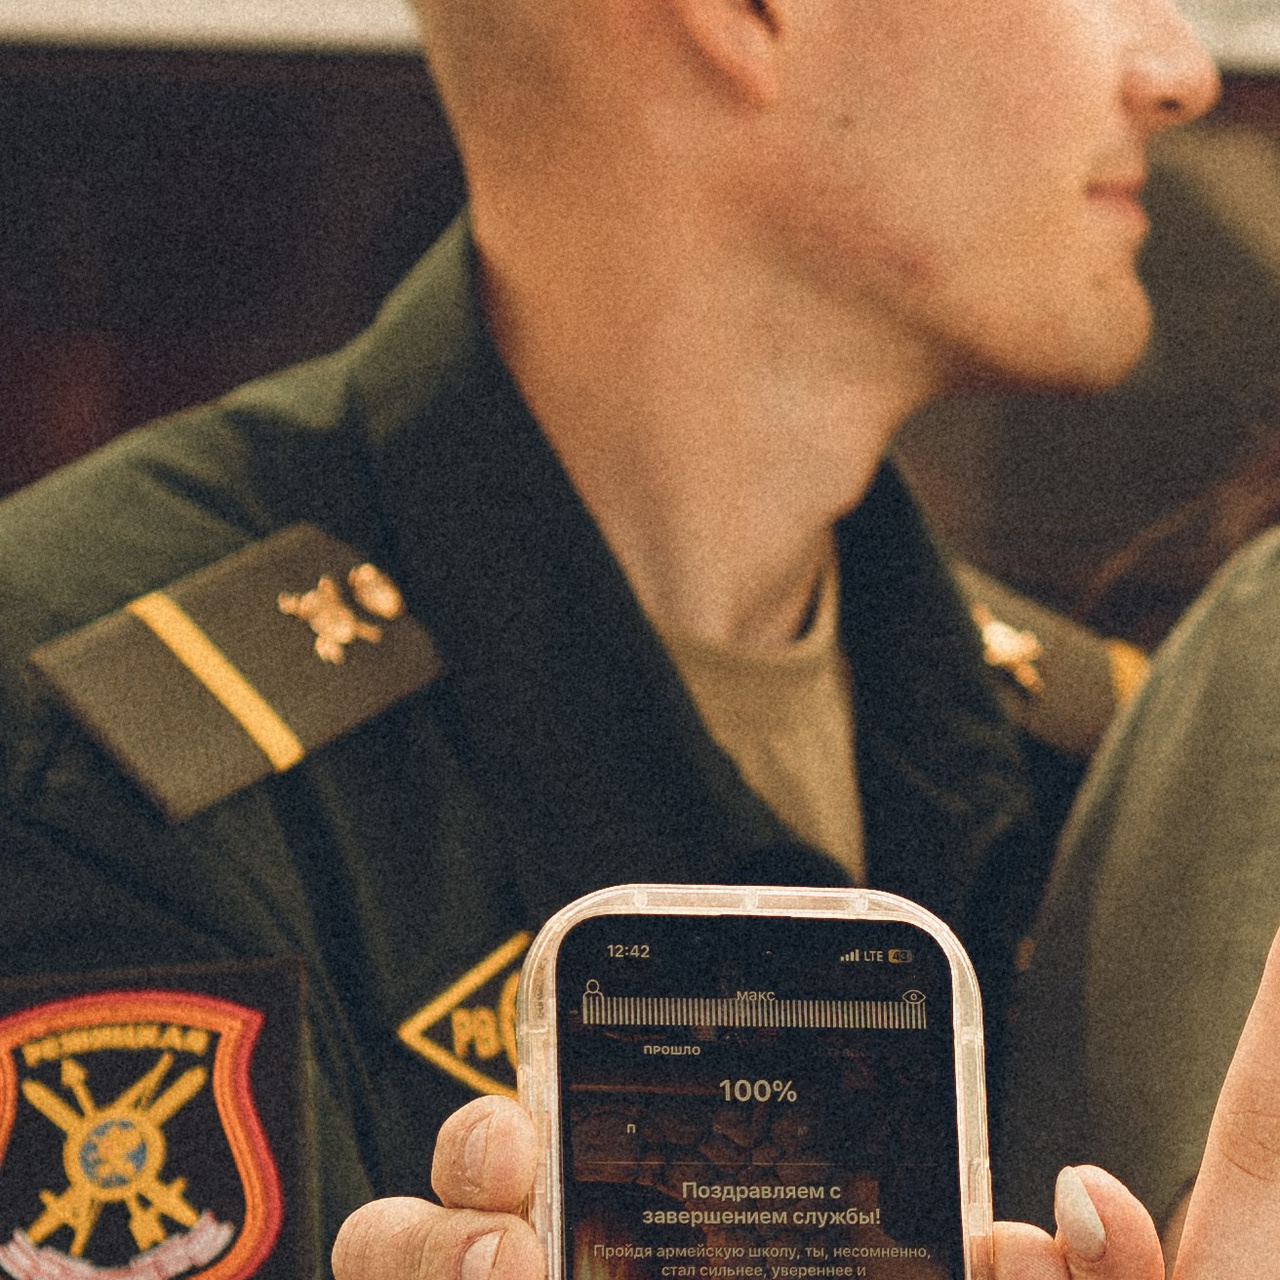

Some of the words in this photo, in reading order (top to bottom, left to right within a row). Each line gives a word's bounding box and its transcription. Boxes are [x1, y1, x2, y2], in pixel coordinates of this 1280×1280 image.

[607, 945, 650, 959] 12:42
[864, 950, 883, 962] LTE
[737, 991, 775, 1001] макс
[643, 1045, 701, 1057] прошло
[719, 1080, 798, 1103] 100%
[682, 1182, 824, 1202] Поздравляем
[830, 1186, 840, 1199] с
[642, 1210, 787, 1227] завершением
[793, 1208, 881, 1228] службы!
[593, 1244, 652, 1260] Пройдя
[656, 1244, 744, 1260] армейскую
[748, 1248, 799, 1260] школу,
[804, 1248, 829, 1260] ты,
[834, 1248, 931, 1260] несомненно,
[661, 1266, 695, 1276] стал
[700, 1266, 767, 1279] сильнее,
[772, 1266, 852, 1279] увереннее
[857, 1266, 866, 1276] и
